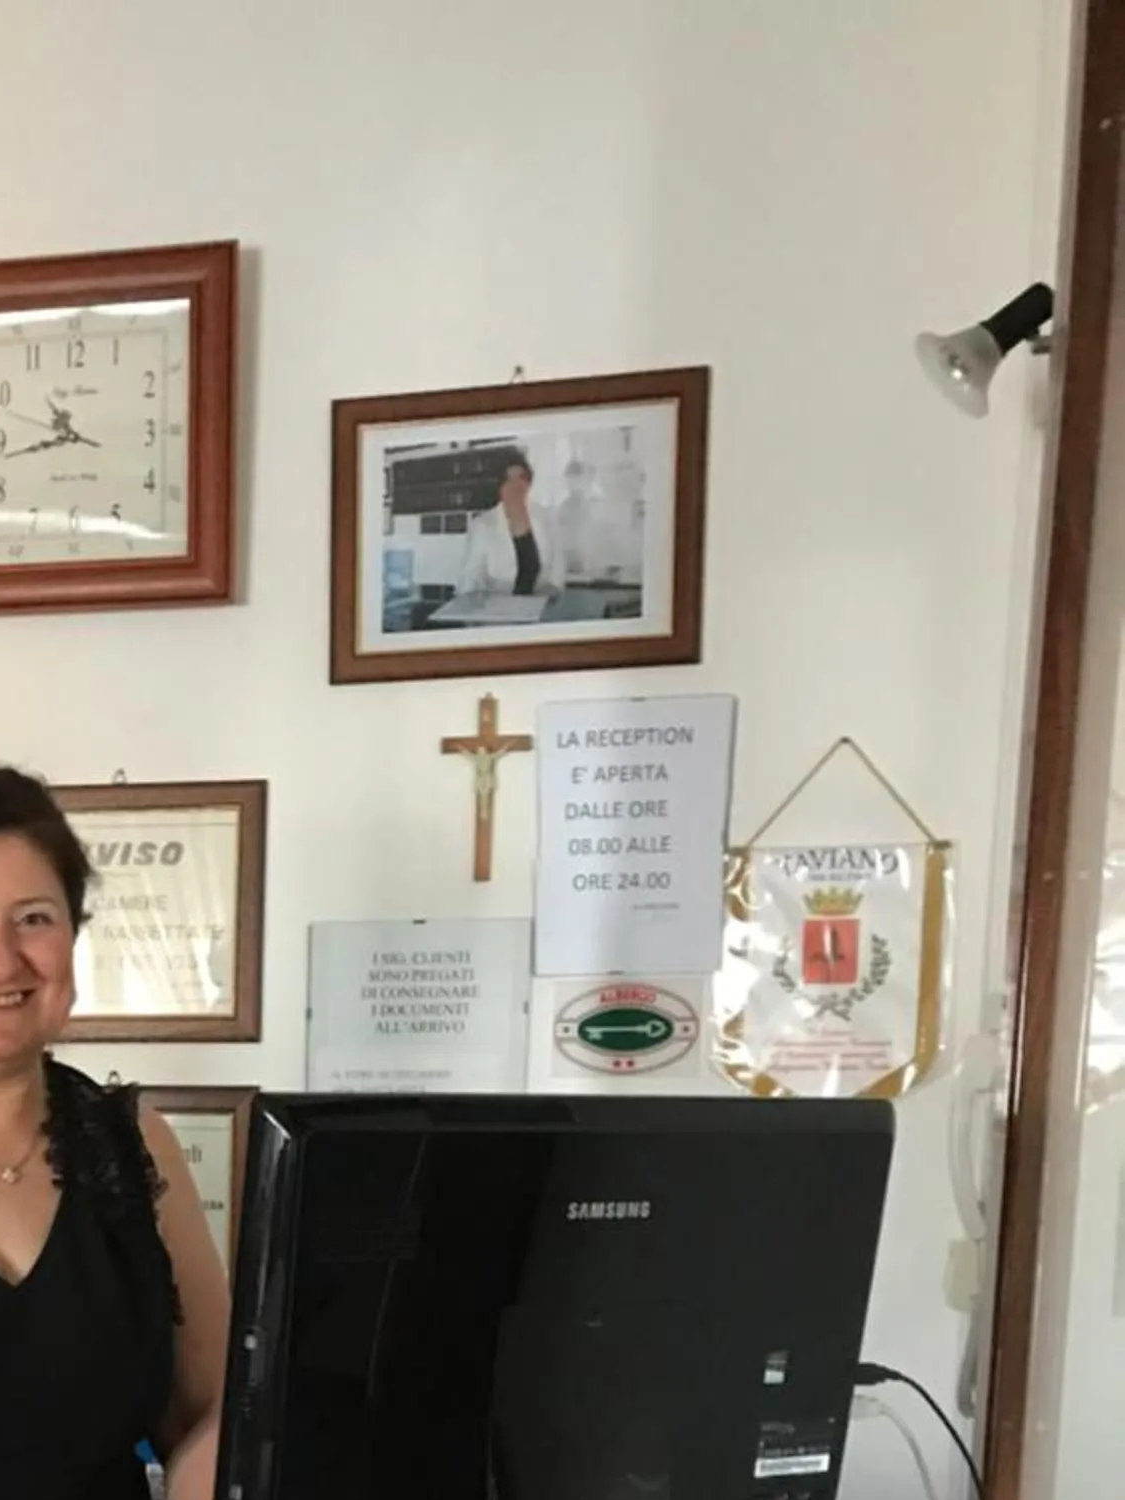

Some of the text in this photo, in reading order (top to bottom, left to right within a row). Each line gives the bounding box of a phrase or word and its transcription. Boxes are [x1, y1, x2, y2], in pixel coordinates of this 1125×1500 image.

[26, 338, 120, 371] 11 12 1
[142, 370, 156, 398] 2
[143, 418, 156, 447] 3
[143, 468, 156, 494] 4
[556, 726, 695, 748] LA RECEPTION
[593, 764, 669, 782] APERTA
[565, 800, 668, 820] DALLE ORE
[85, 840, 186, 866] VISO
[626, 835, 672, 853] ALLE
[572, 872, 671, 891] ORE 24.00
[412, 951, 471, 965] CLIENTI
[368, 968, 475, 982] SONO PREGATI
[362, 985, 479, 999] DI CONSEGNARE
[381, 1003, 470, 1017] DOCUMENTI
[375, 1020, 465, 1034] ALL'ARRIVO
[566, 1201, 651, 1220] SAMSUNG
